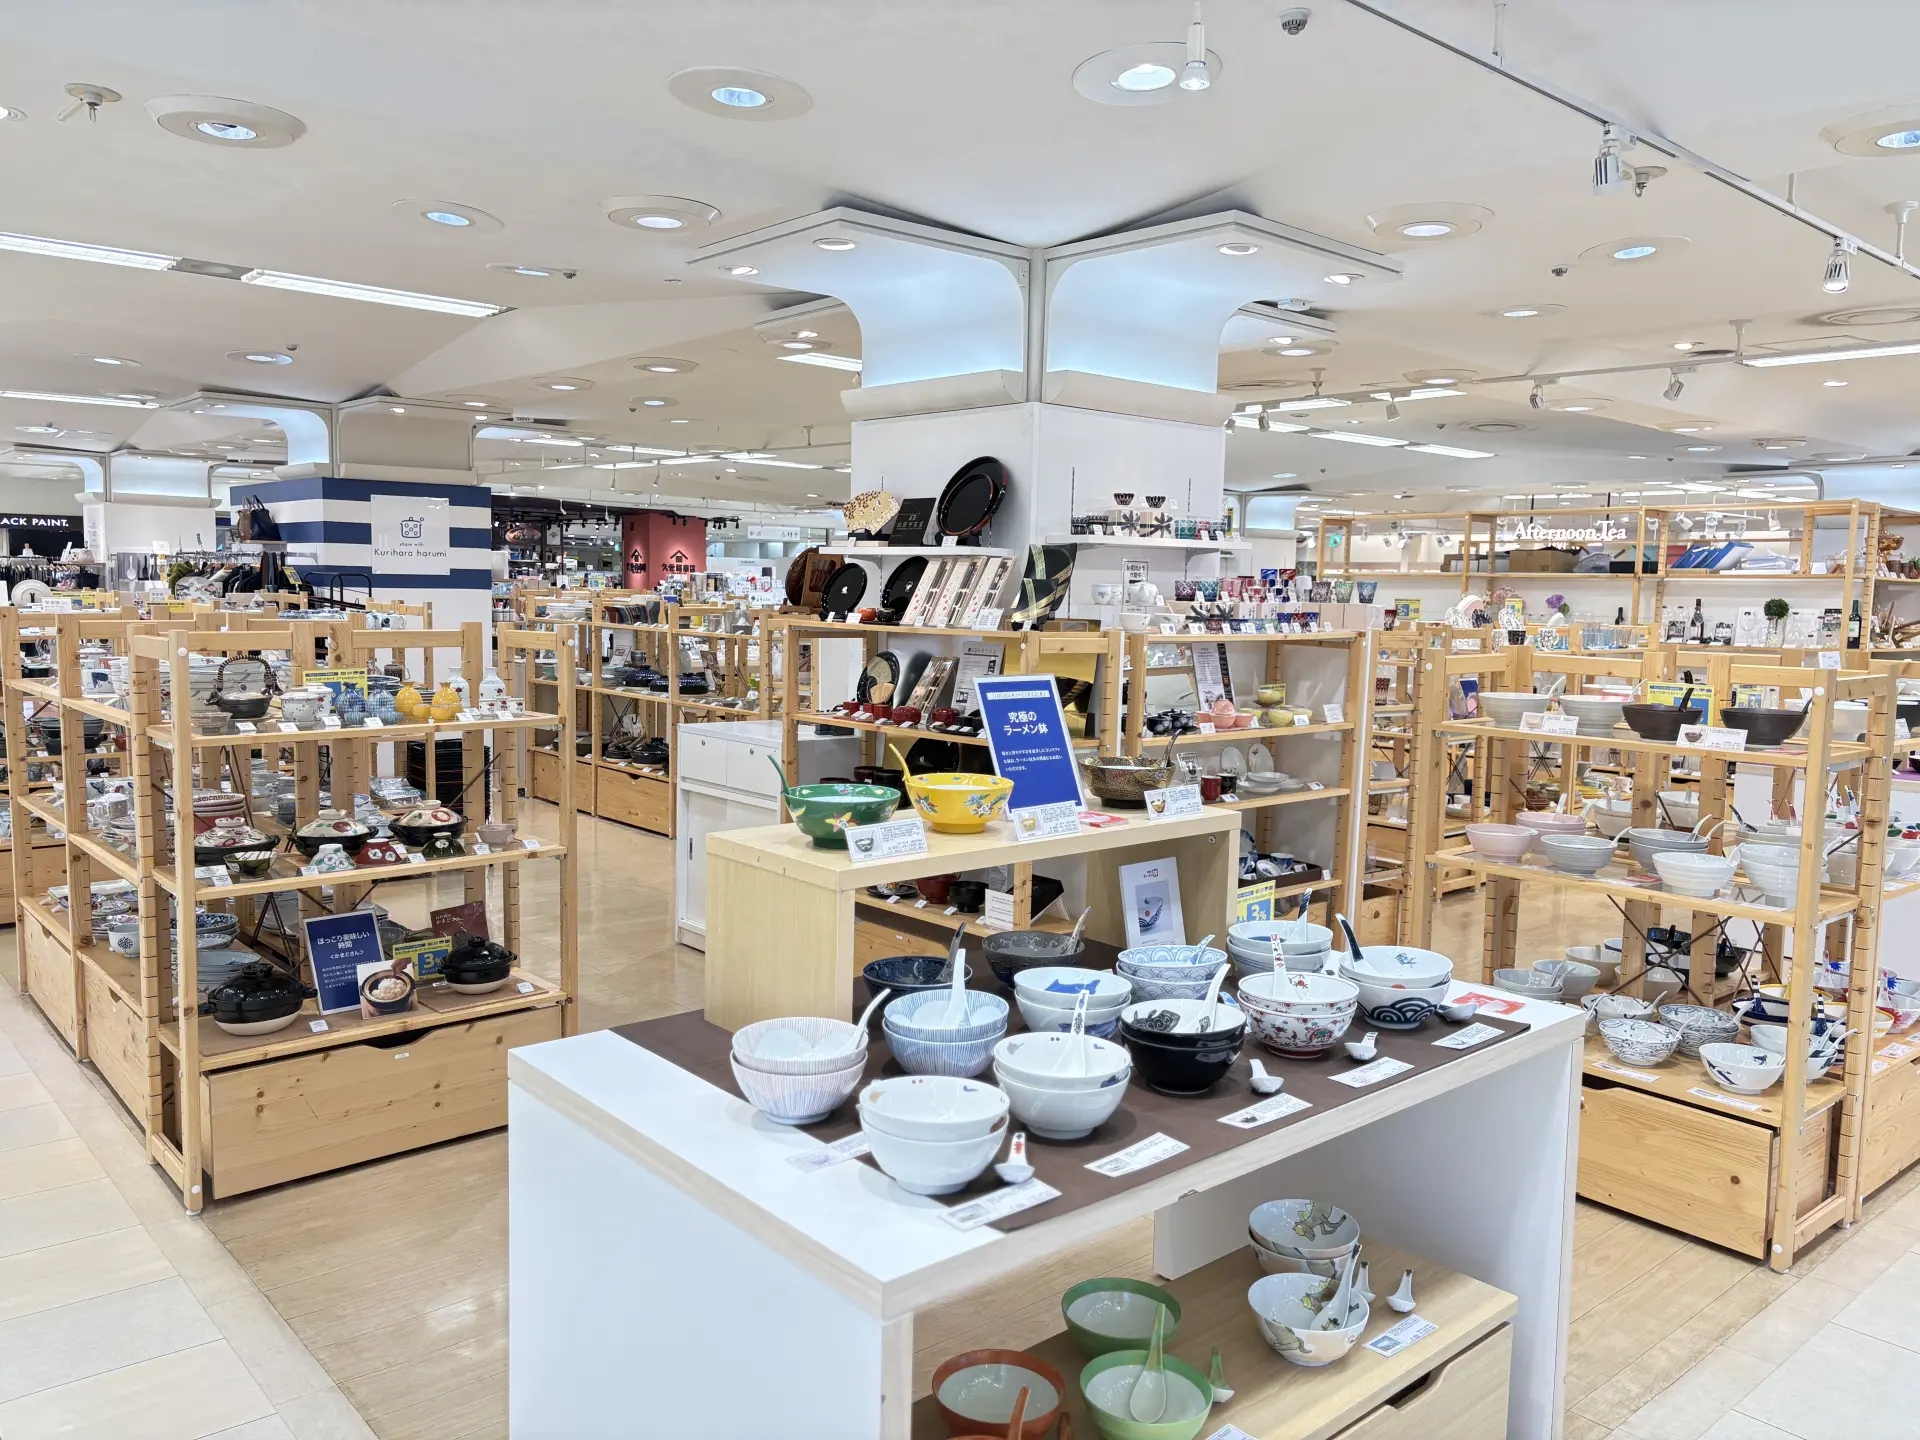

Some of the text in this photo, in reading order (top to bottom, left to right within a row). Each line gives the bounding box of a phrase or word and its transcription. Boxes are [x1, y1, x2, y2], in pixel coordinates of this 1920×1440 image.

[32, 518, 69, 527] PAINT.
[1513, 519, 1628, 542] Afternoon Tea
[374, 548, 447, 558] Kurihara harumi
[1007, 711, 1037, 723] 究極の
[1003, 722, 1049, 736] ラーメン鉢
[317, 931, 371, 946] ほっこり美味しい
[337, 940, 353, 949] 時間
